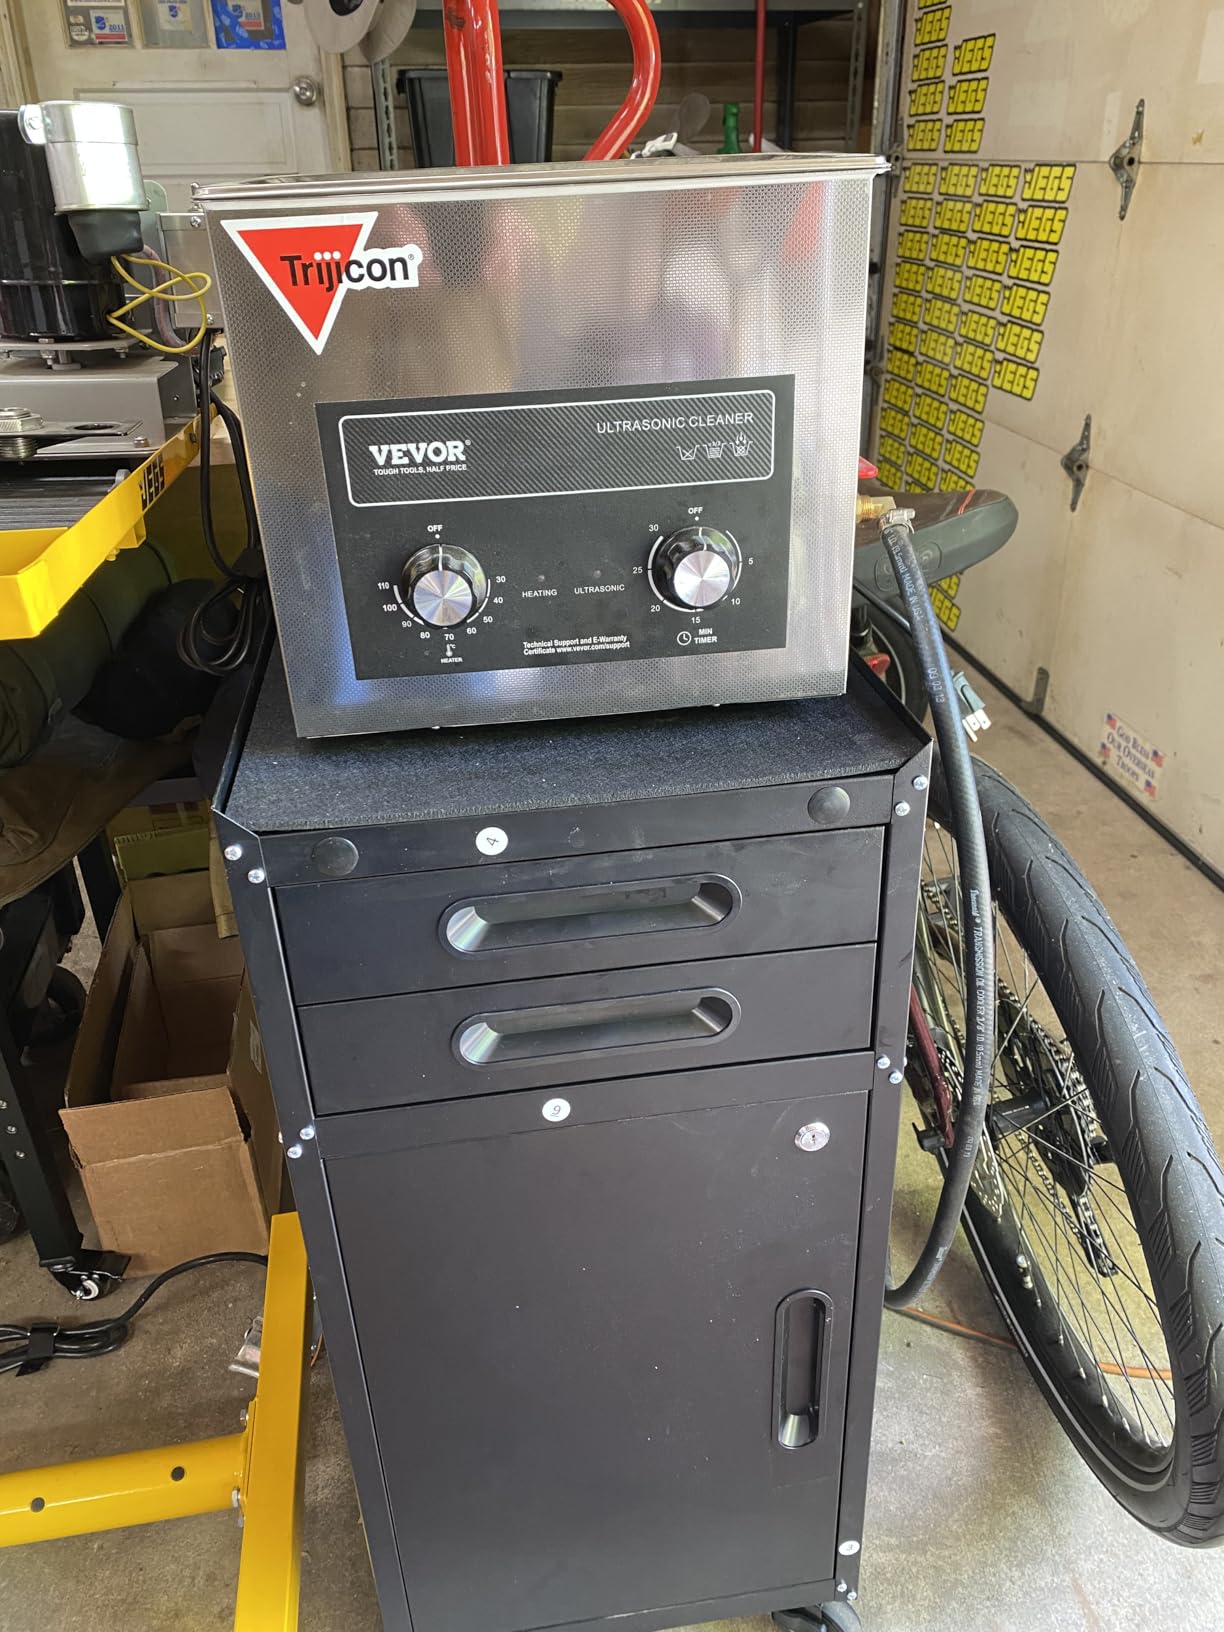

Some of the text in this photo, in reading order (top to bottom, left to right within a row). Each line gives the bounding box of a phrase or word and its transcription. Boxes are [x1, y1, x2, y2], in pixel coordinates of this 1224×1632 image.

[914, 8, 951, 43] JEGS
[912, 47, 947, 79] JEGS
[952, 35, 995, 73] JEGS
[909, 82, 944, 116] JEGS
[947, 79, 988, 112] JEGS
[907, 121, 942, 149] JEGS
[944, 120, 984, 151] JEGS
[903, 165, 937, 193] JEGS
[939, 163, 978, 195] JEGS
[979, 164, 1020, 198] JEGS
[1022, 165, 1076, 201] JEGS
[900, 199, 932, 227] JEGS
[934, 200, 973, 232] JEGS
[972, 201, 1016, 235] JEGS
[1015, 205, 1068, 242] JEGS
[897, 231, 929, 260] JEGS
[930, 233, 968, 265] JEGS
[968, 239, 1010, 274] JEGS
[280, 250, 409, 292] Trijicon
[895, 262, 926, 292] JEGS
[1008, 246, 1058, 284] JEGS
[926, 267, 963, 298] JEGS
[963, 274, 1002, 309] JEGS
[891, 293, 922, 321] JEGS
[923, 298, 960, 332] JEGS
[1001, 284, 1050, 324] JEGS
[888, 322, 919, 352] JEGS
[959, 310, 996, 345] JEGS
[996, 322, 1042, 363] JEGS
[919, 330, 955, 364] JEGS
[954, 342, 994, 380] JEGS
[886, 350, 916, 380] JEGS
[915, 362, 951, 395] JEGS
[992, 360, 1039, 399] JEGS
[883, 379, 913, 411] JEGS
[949, 374, 988, 413] JEGS
[597, 412, 754, 434] ULTRASONIC CLEANER
[913, 394, 948, 429] JEGS
[909, 424, 944, 460] JEGS
[948, 410, 984, 446] JEGS
[369, 440, 466, 466] VEVOR
[944, 441, 979, 477] JEGS
[138, 452, 166, 511] JEGS
[374, 468, 399, 476] TOUGH
[400, 467, 425, 475] TOOLS,
[426, 465, 445, 473] HALF
[905, 453, 939, 489] JEGS
[688, 507, 703, 515] OFF
[427, 525, 443, 533] OFF
[648, 524, 659, 532] 30
[632, 566, 643, 574] 25
[901, 572, 915, 596] MADE
[377, 582, 390, 590] 110
[493, 596, 504, 604] 40
[522, 589, 557, 598] HEATING
[574, 584, 625, 594] ULTRASONIC
[907, 595, 917, 604] IN
[382, 603, 397, 611] 100
[483, 615, 493, 623] 50
[650, 604, 661, 613] 20
[691, 616, 701, 624] 15
[401, 620, 412, 628] 90
[444, 633, 454, 641] 70
[466, 627, 477, 635] 60
[694, 635, 718, 644] TIMER
[523, 640, 553, 649] Technical
[554, 638, 579, 648] Support
[593, 635, 627, 645] E-Warranty
[524, 642, 630, 655] Certificate www.vevor.com/support
[927, 666, 946, 704] 09 03 13
[972, 926, 986, 977] TRANSMISSION
[975, 977, 984, 986] OIL
[975, 989, 984, 1014] COOLER
[972, 1069, 982, 1086] MADE
